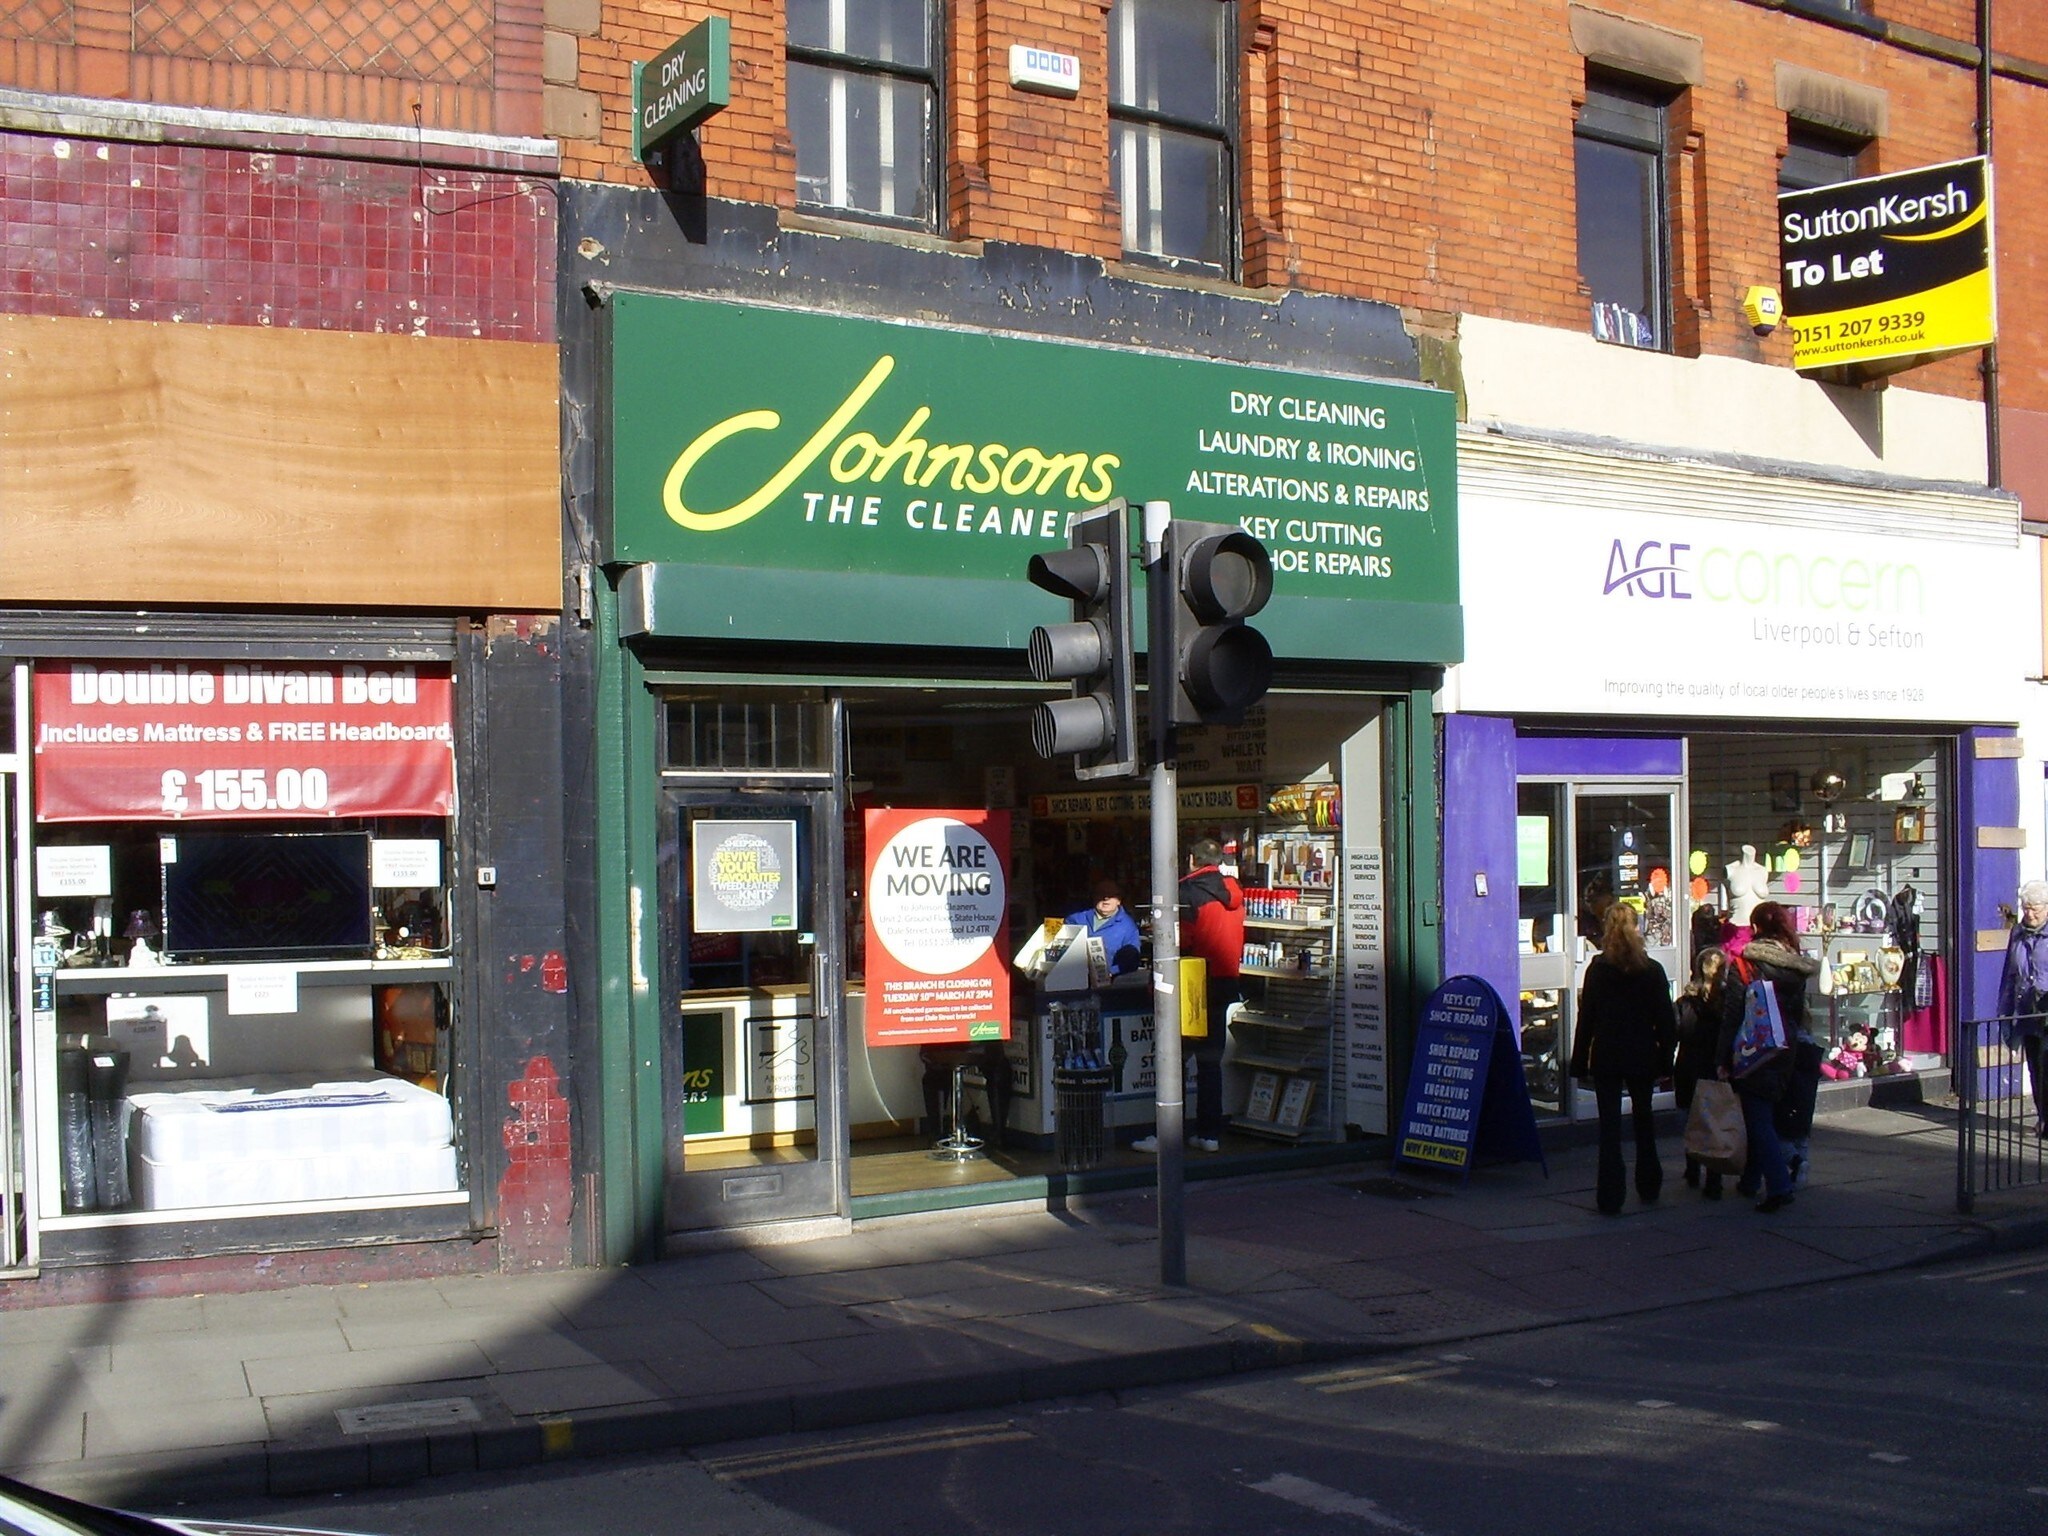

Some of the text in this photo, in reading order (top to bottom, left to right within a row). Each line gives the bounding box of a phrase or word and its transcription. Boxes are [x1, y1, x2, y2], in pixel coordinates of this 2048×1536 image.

[661, 50, 687, 88] DRY
[644, 68, 706, 130] CLEANING
[1783, 181, 1968, 243] SuttonKersh
[1786, 249, 1884, 288] To Let
[1793, 311, 1926, 344] 0151 207 9339
[1230, 391, 1386, 429] DRY CLEANING
[663, 355, 1121, 531] Johnsons
[1199, 429, 1416, 472] LAUNDRY & IRONING
[1187, 470, 1430, 512] ALTERATIONS & REPAIRS
[803, 493, 1073, 538] THE CLEANE
[1240, 516, 1382, 547] KEY CUTTING
[1269, 549, 1391, 578] HOE REPAIRS
[1603, 538, 1926, 614] AGE concern
[1753, 617, 1924, 649] Liverpool & Sefton
[71, 663, 417, 704] Double Divan Bed
[1604, 678, 1663, 698] Improving
[1666, 681, 1685, 696] the
[1688, 682, 1725, 700] quality
[1729, 682, 1741, 697] of
[1743, 683, 1769, 698] local
[1771, 684, 1798, 699] older
[1847, 685, 1870, 701] lives
[1872, 687, 1898, 702] since
[41, 722, 450, 743] Includes Mattress & FREE Headboard
[161, 768, 328, 811] £ 155.00
[1206, 791, 1232, 806] REPAIRS
[717, 852, 756, 862] REVIVE
[718, 862, 756, 873] YOUR
[892, 845, 987, 868] WE ARE
[717, 873, 780, 883] FAVOURITES
[887, 873, 992, 896] MOVING
[739, 890, 773, 900] KNITS
[954, 914, 973, 922] State
[883, 993, 919, 1002] TUESDAY
[936, 992, 965, 1000] MARCH
[1443, 993, 1482, 1006] KEYS CUT
[1429, 1009, 1488, 1027] SHOE REPAIRS
[1428, 1043, 1479, 1061] SHOE REPAIRS
[1427, 1063, 1474, 1081] KEY CUTTING
[1424, 1082, 1469, 1100] ENGRAVING
[1416, 1102, 1470, 1121] WATCH STRAPS
[1409, 1121, 1469, 1142] WATCH BATTERIES
